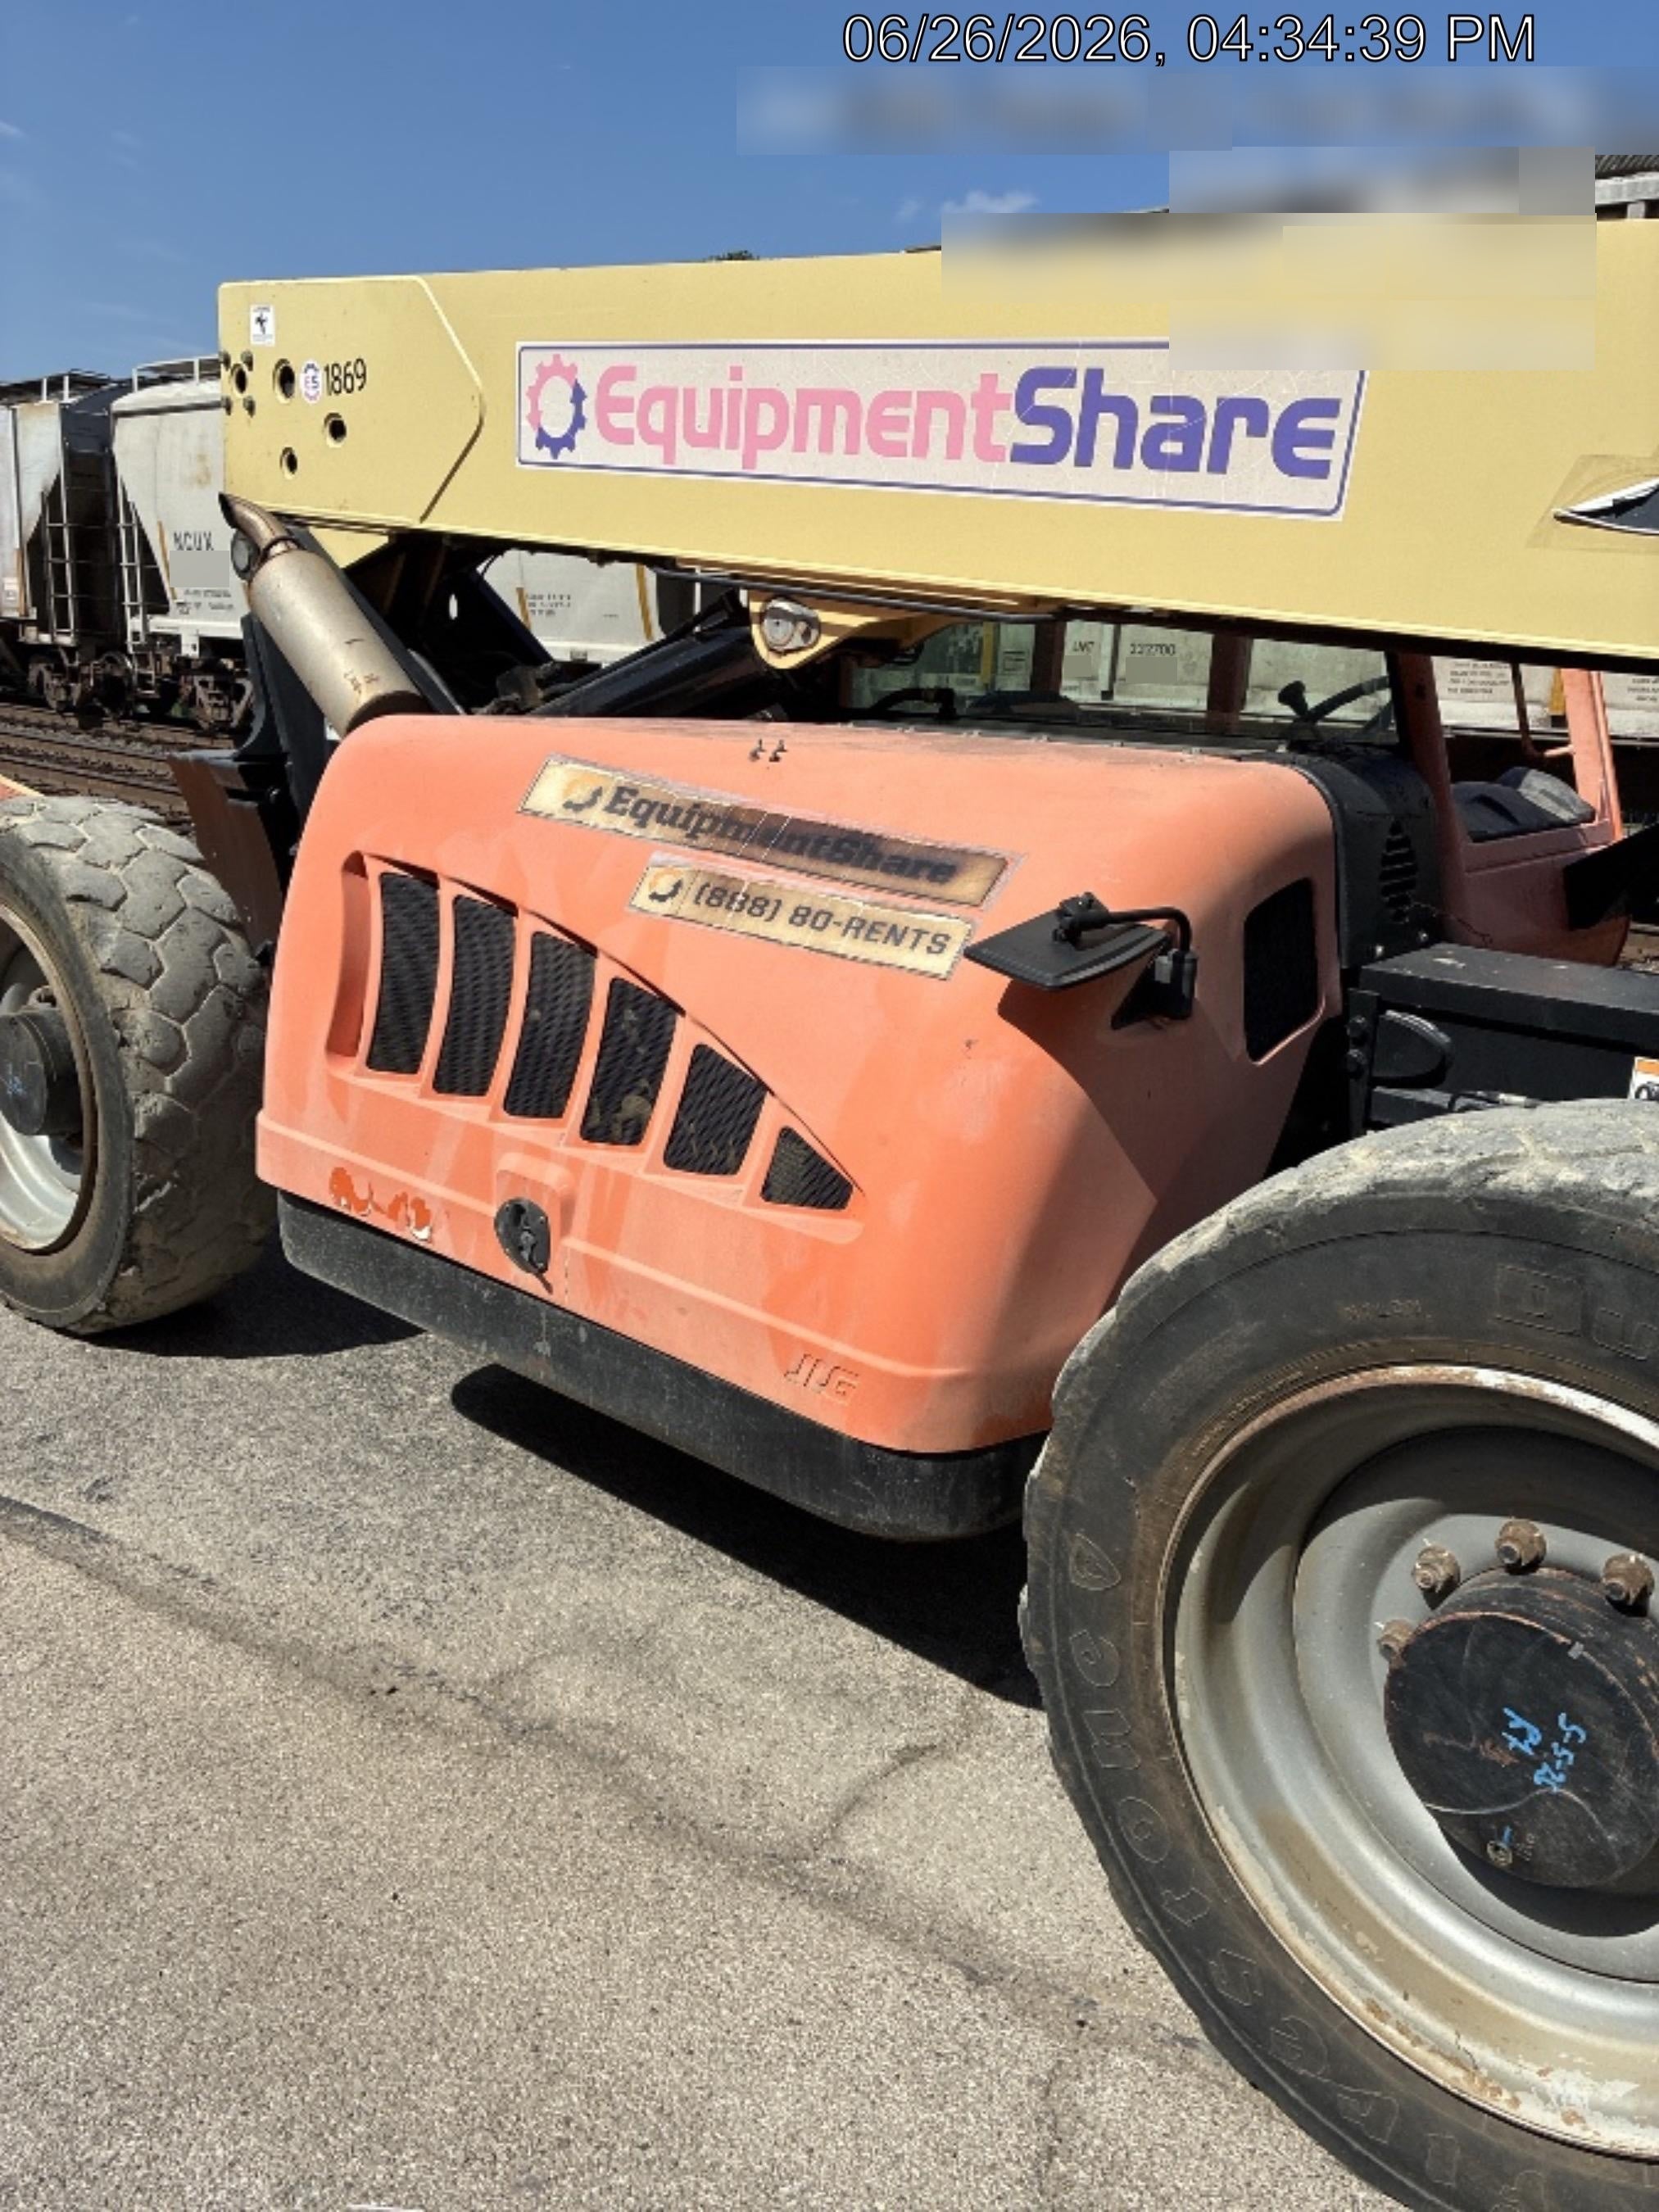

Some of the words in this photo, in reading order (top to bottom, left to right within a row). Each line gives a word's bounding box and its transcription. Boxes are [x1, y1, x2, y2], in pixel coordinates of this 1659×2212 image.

[323, 358, 368, 397] 1869
[593, 364, 1341, 481] EquipmentShare
[693, 882, 782, 922] (888)
[787, 902, 953, 955] 80-RENTS
